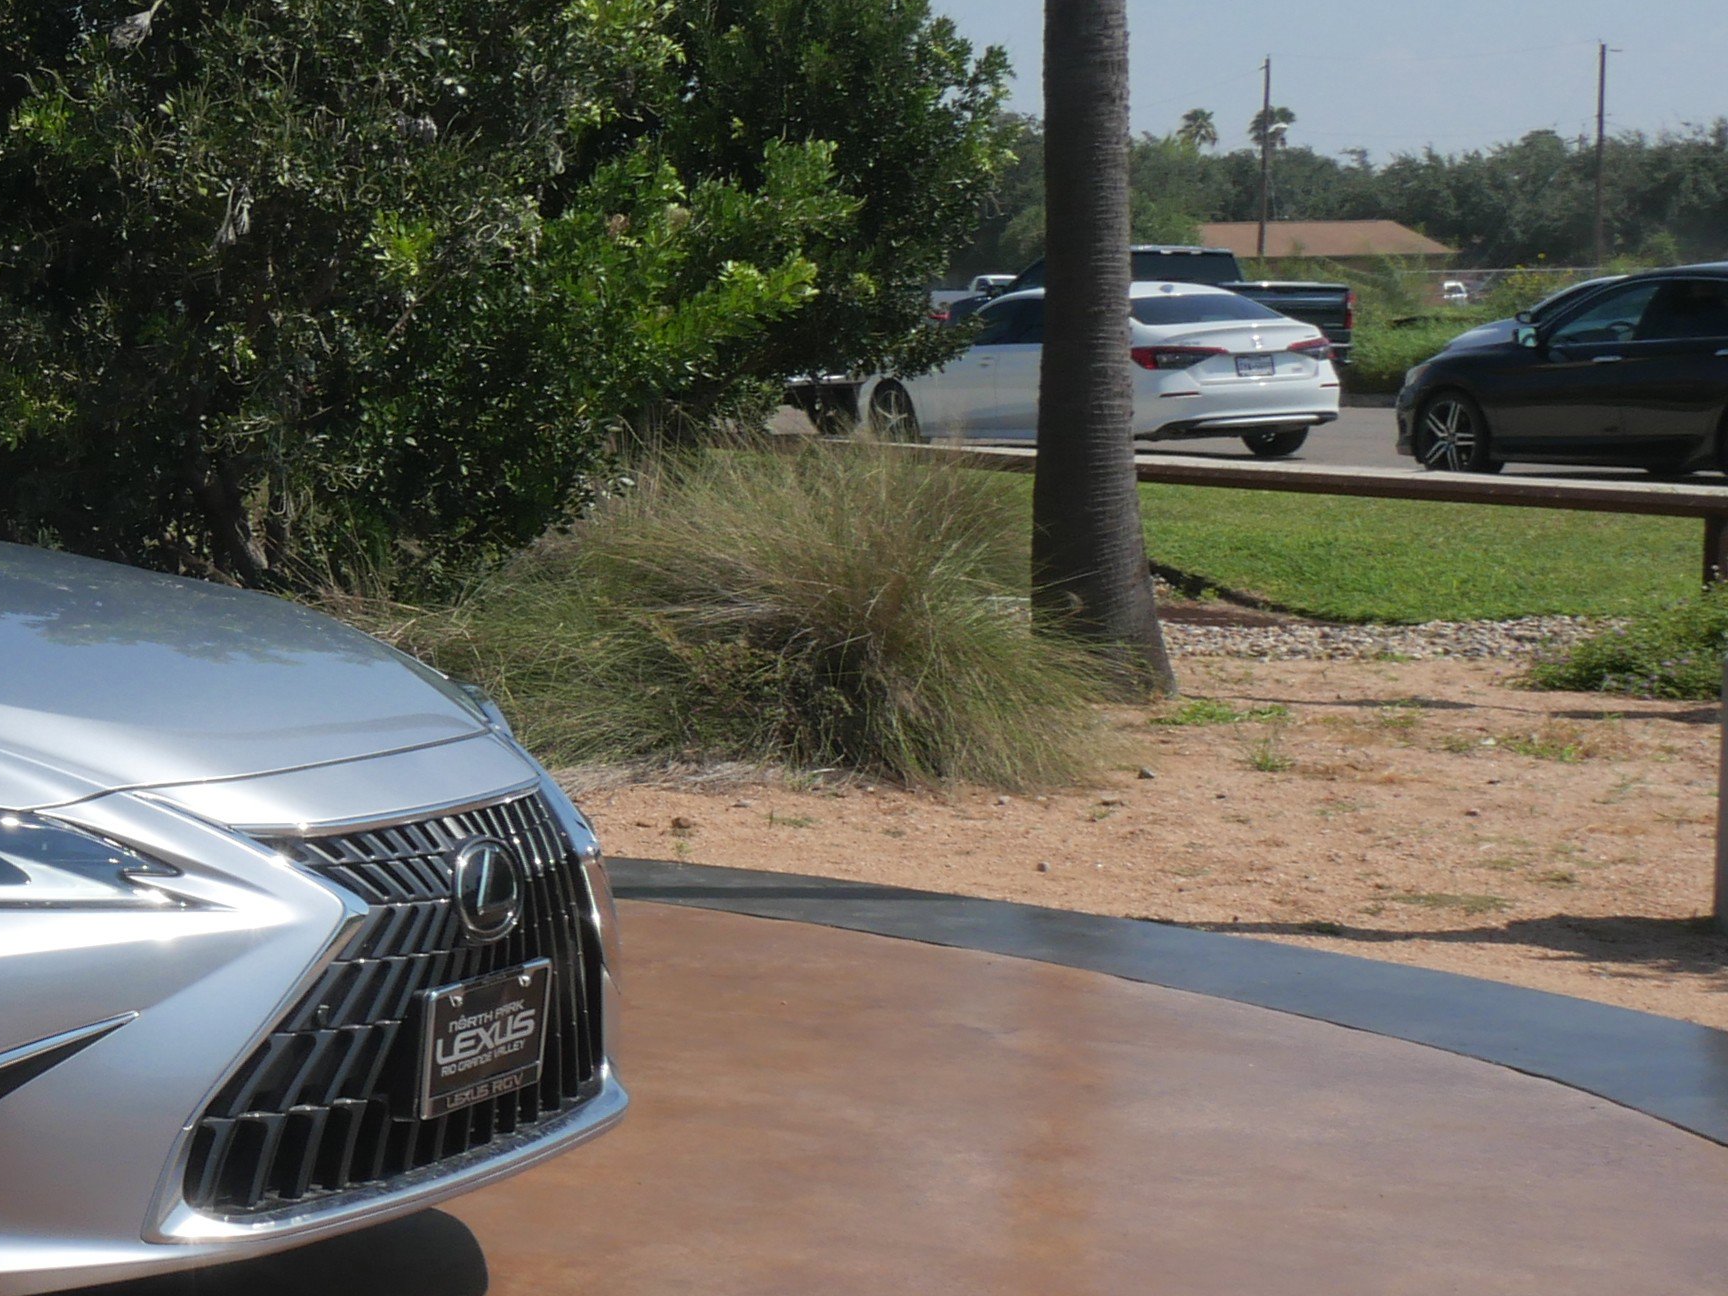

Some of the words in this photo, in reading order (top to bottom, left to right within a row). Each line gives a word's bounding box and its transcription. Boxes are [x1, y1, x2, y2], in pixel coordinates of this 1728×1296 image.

[448, 1010, 493, 1033] NORTH
[495, 999, 524, 1018] PARK
[436, 1009, 535, 1065] LEXUS
[441, 1063, 456, 1077] RIO
[458, 1051, 492, 1071] GRANDE
[494, 1039, 525, 1058] VALLEY
[447, 1084, 489, 1108] LEXUS
[492, 1073, 523, 1093] RGV
